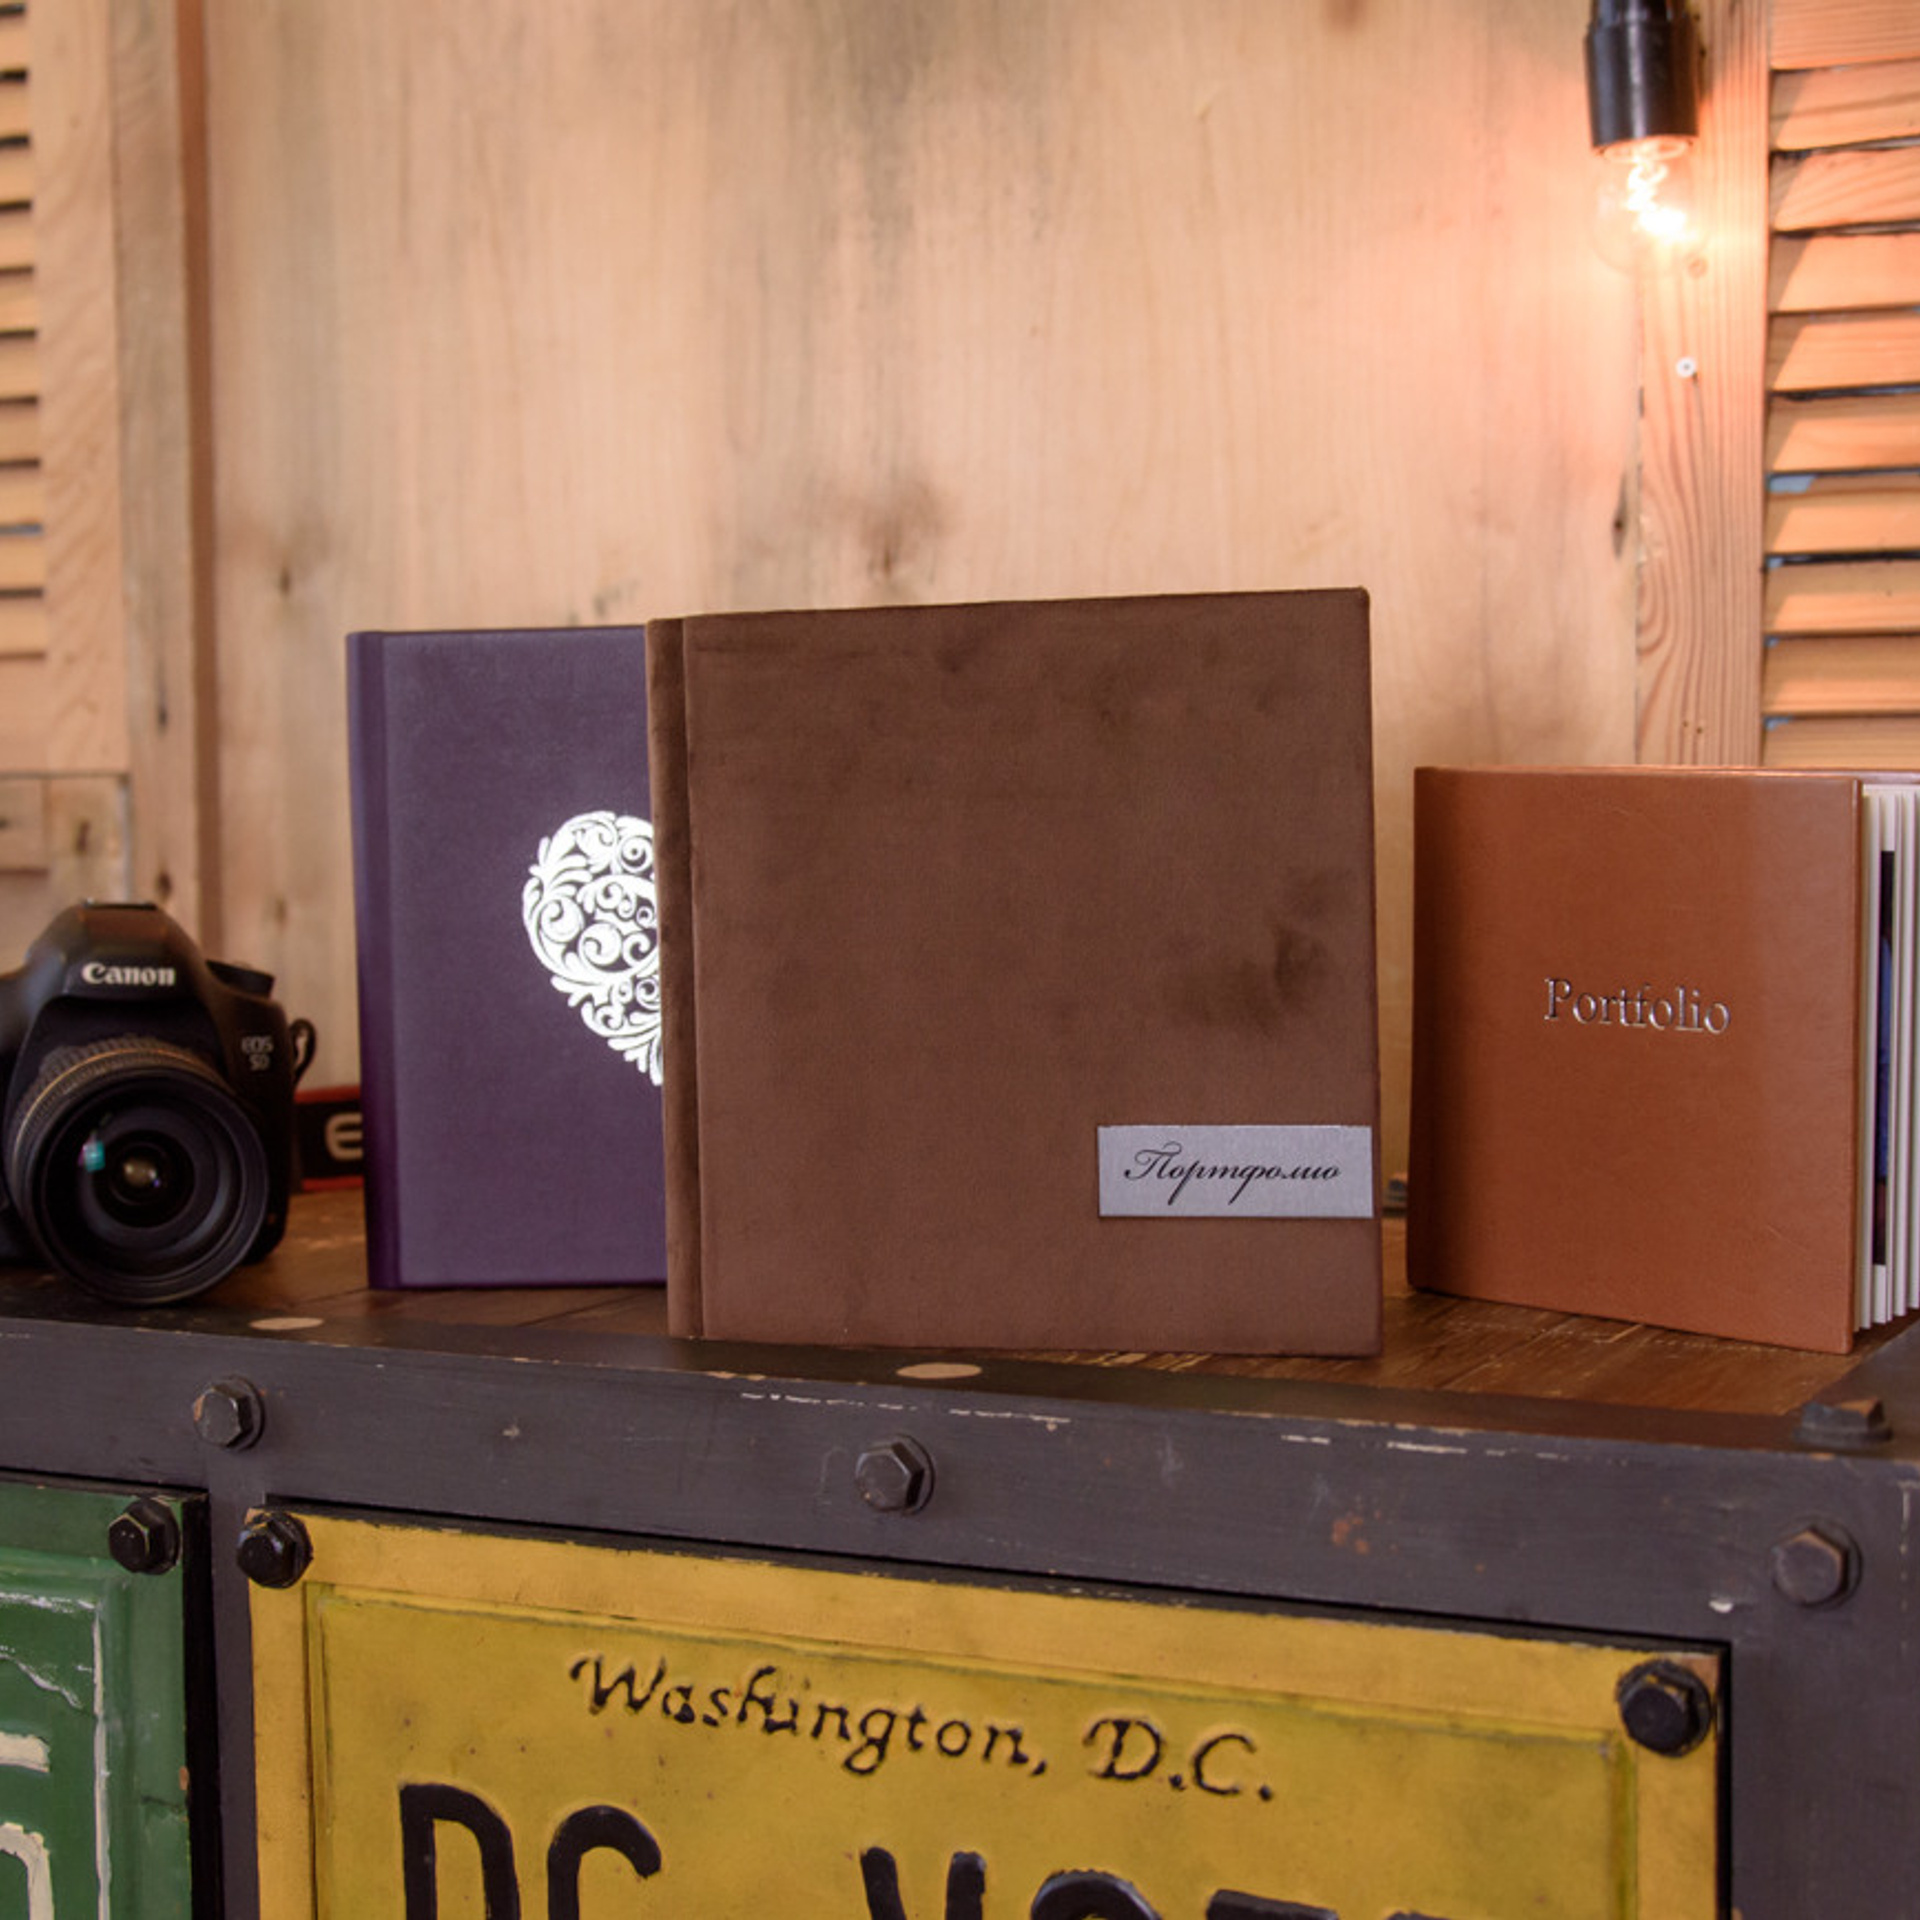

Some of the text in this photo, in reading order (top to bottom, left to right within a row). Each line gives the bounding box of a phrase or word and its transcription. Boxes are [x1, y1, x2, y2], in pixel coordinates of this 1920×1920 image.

[81, 962, 175, 986] Canon
[1544, 978, 1731, 1034] Portfolio
[241, 1036, 274, 1053] EOS
[1123, 1141, 1341, 1206] Портфолио
[569, 1654, 1273, 1801] Washington, D.C.
